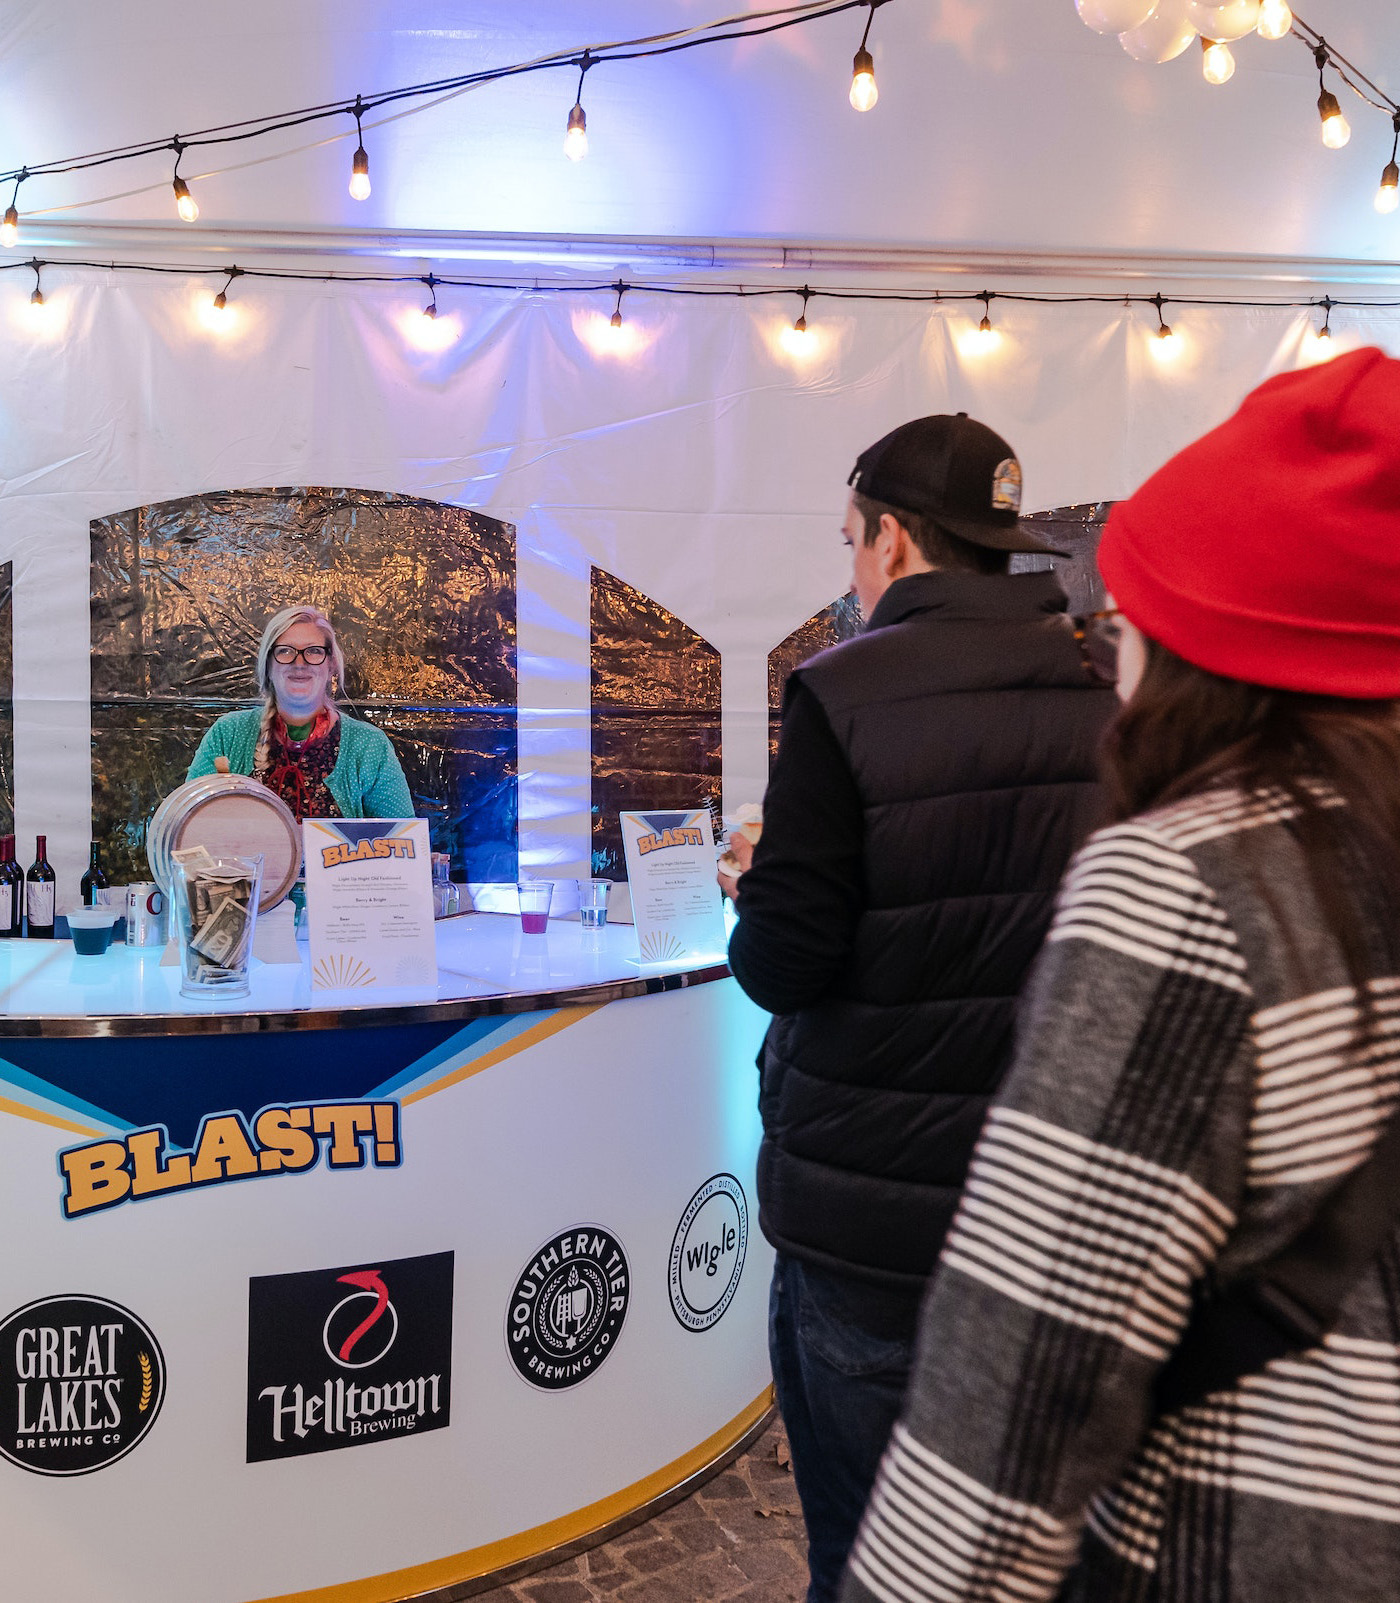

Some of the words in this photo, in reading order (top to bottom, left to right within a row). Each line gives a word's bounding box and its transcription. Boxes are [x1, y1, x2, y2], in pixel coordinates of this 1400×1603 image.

[321, 838, 415, 868] BLAST!
[637, 828, 703, 856] BLAST!
[60, 1101, 400, 1219] BLAST!
[672, 1245, 680, 1285] MILLED
[680, 1184, 713, 1233] FERMENTED
[718, 1180, 741, 1200] DISTILLED
[513, 1233, 606, 1342] SOUTHERN
[605, 1250, 626, 1312] TIER
[674, 1295, 705, 1326] PITTSBURGH
[15, 1324, 124, 1379] GREAT
[528, 1355, 592, 1379] BREWING
[16, 1379, 122, 1434] LAKES
[258, 1373, 441, 1442] Helltown
[350, 1413, 416, 1437] Brewing
[16, 1435, 94, 1449] BREWING
